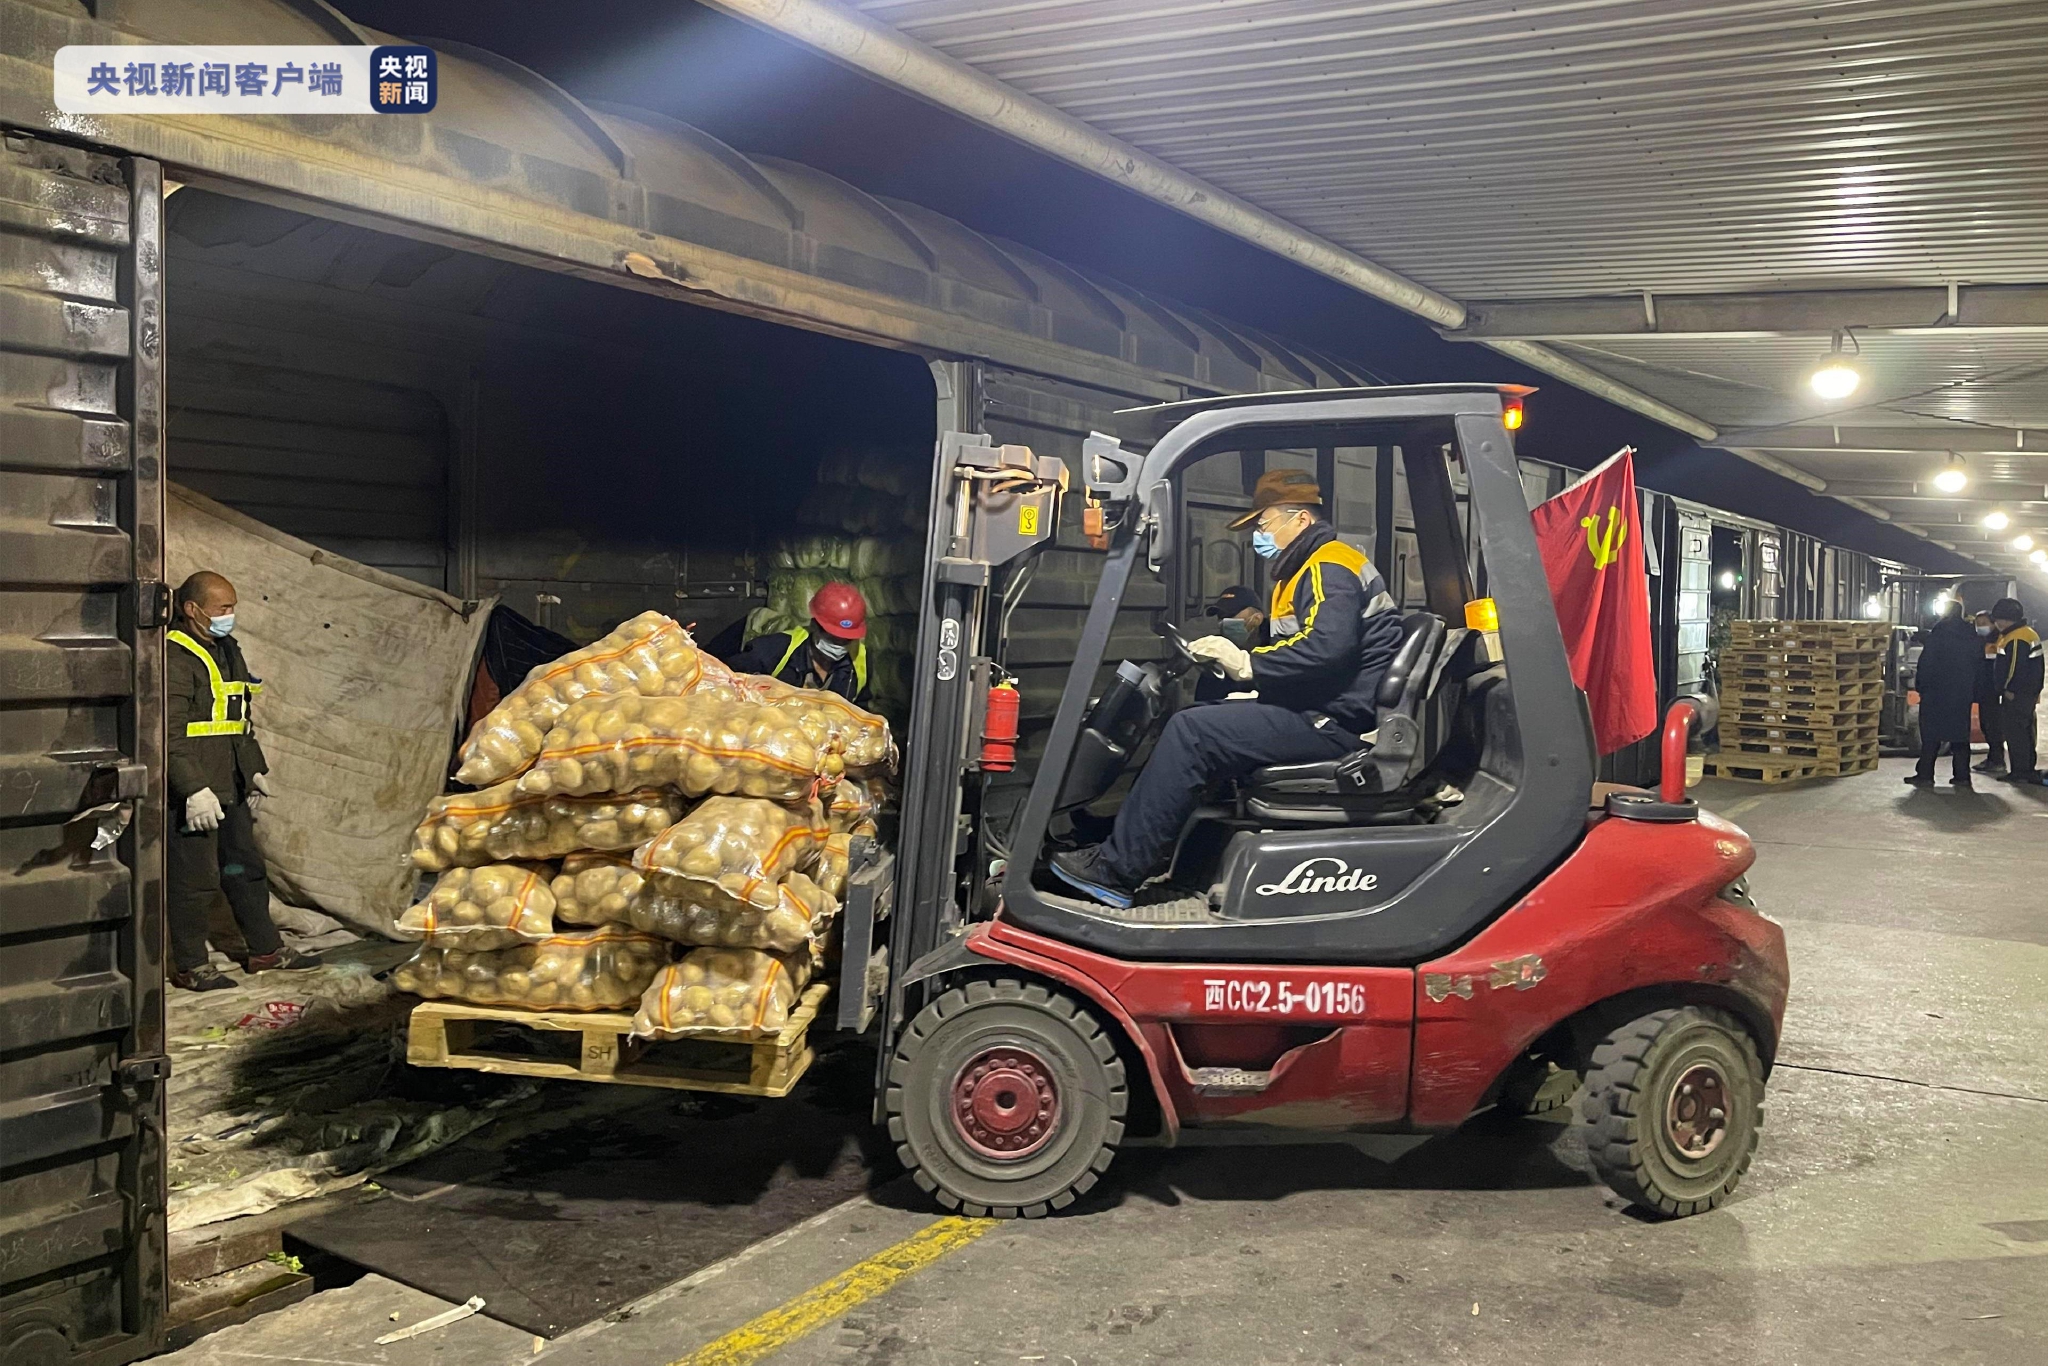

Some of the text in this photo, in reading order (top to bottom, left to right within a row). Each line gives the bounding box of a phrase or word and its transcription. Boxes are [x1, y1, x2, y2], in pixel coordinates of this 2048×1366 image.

[1256, 857, 1378, 896] Linde
[1204, 979, 1366, 1015] 西CC2.5-0156
[588, 1045, 612, 1060] SH
